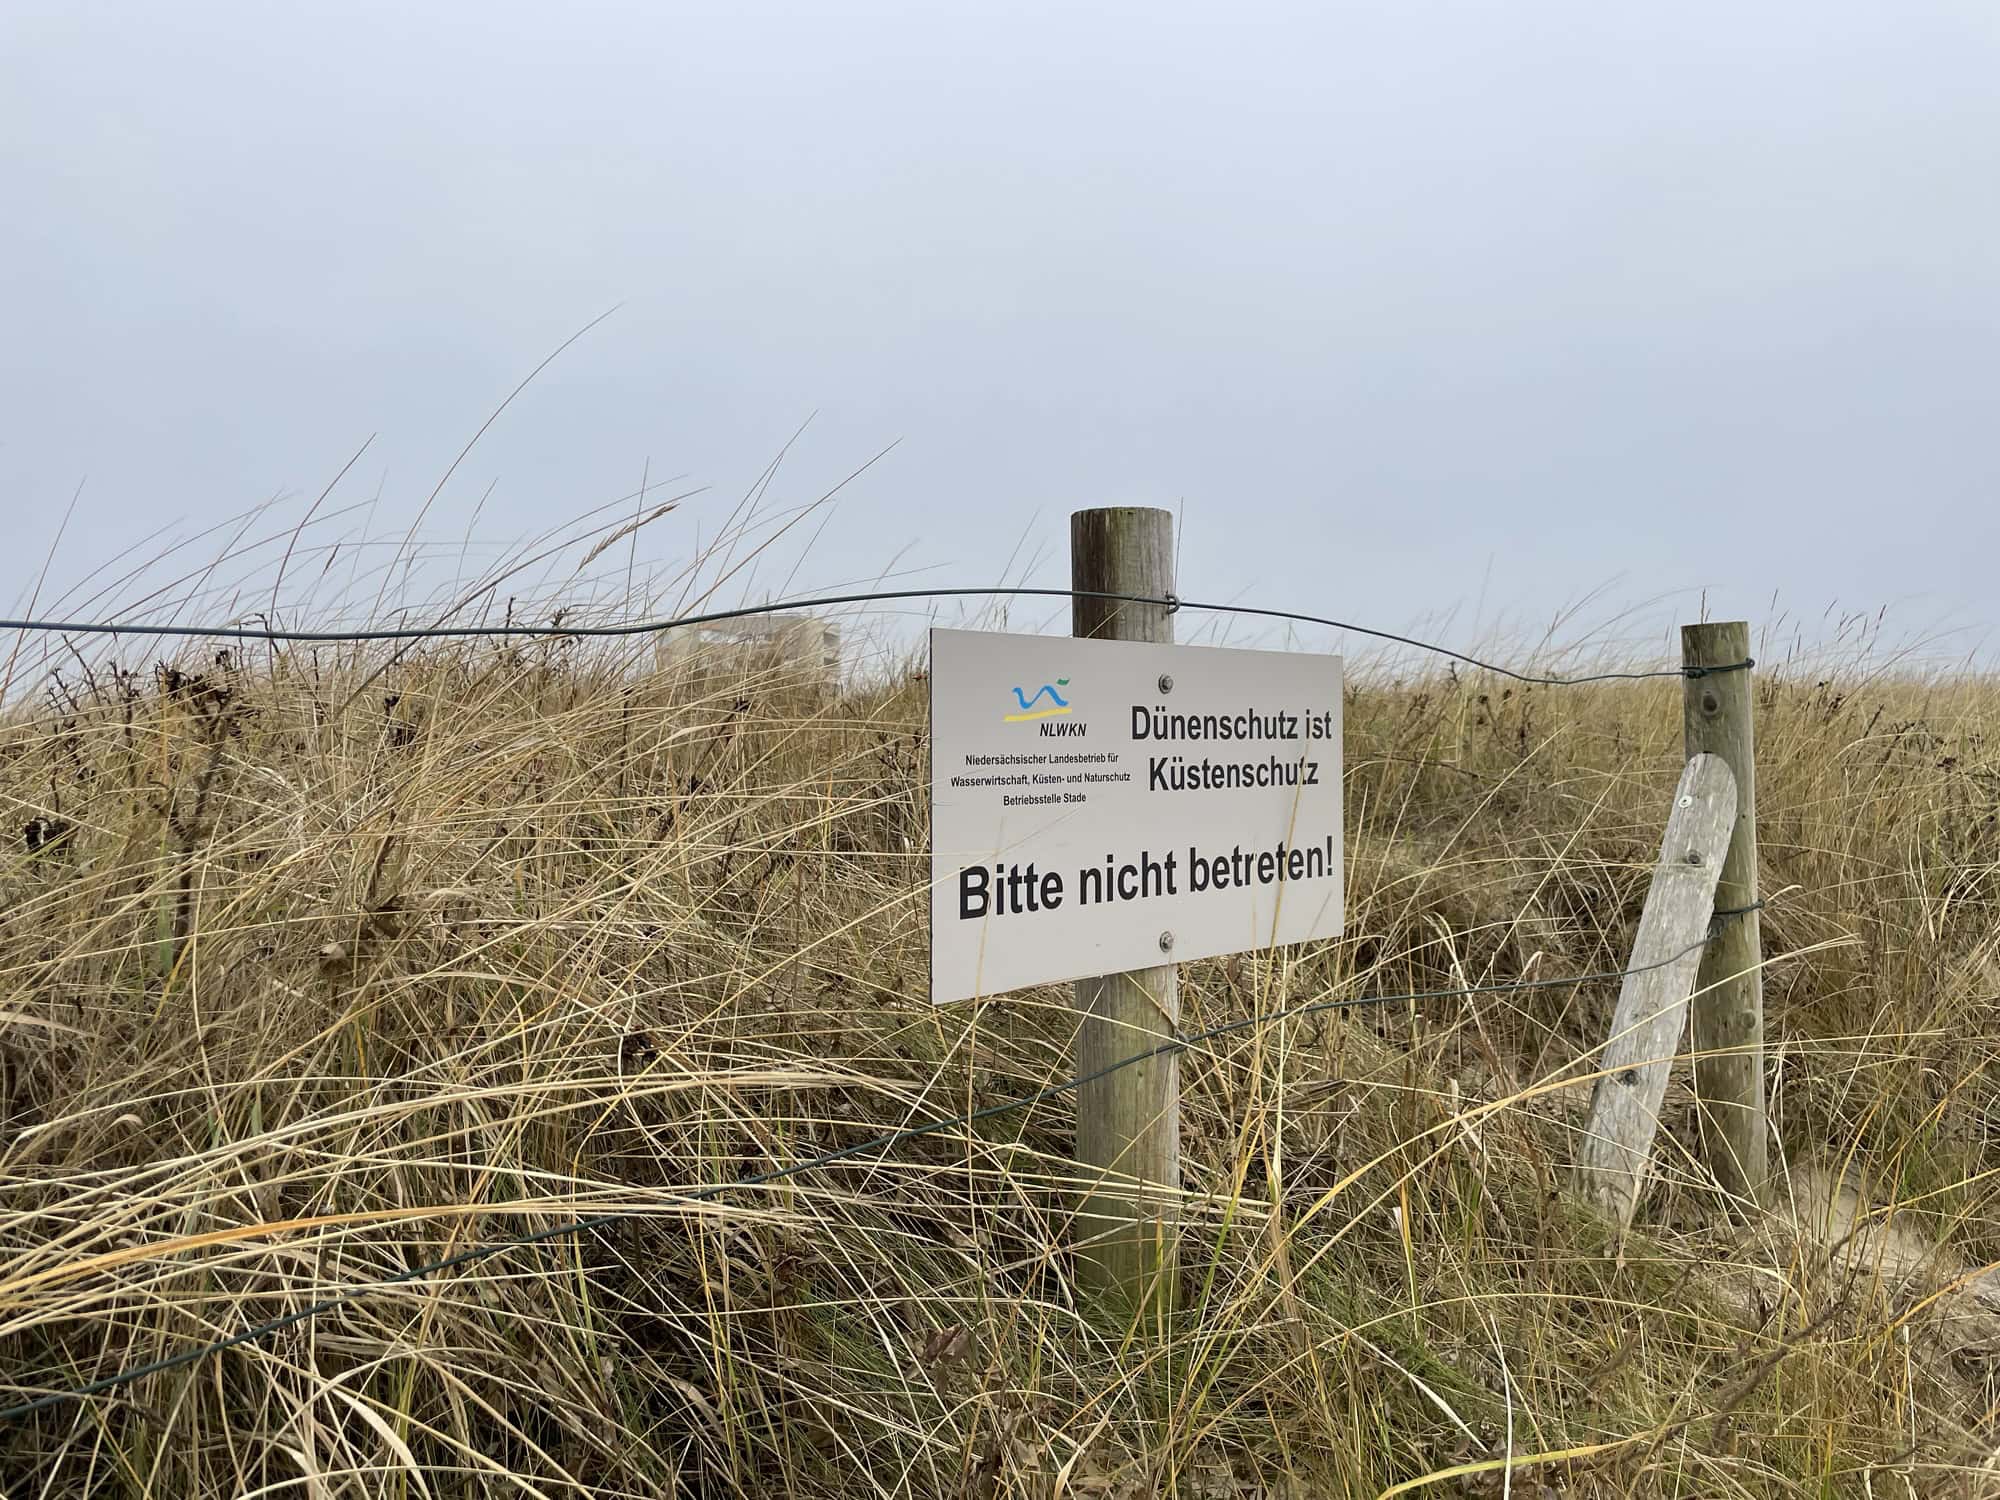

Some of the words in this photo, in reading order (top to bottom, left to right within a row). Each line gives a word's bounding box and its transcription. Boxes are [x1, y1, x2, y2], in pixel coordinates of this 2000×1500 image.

[1039, 723, 1087, 737] NLWKN
[1131, 705, 1299, 740] Dünenschutz
[1305, 708, 1332, 740] ist
[965, 754, 1047, 766] Niedersächsischer
[1049, 753, 1106, 765] Landesbetrieb
[1107, 752, 1119, 763] für
[950, 775, 1031, 788] Wasserwirtschaft,
[1032, 773, 1065, 785] Küsten-
[1066, 772, 1083, 784] und
[1084, 771, 1131, 783] Naturschutz
[1149, 755, 1319, 791] Küstenschutz
[1003, 794, 1061, 806] Betriebsstelle
[1063, 792, 1087, 804] Stade
[959, 862, 1064, 920] Bitte
[1080, 850, 1177, 906] nicht
[1189, 835, 1334, 893] betreten!
